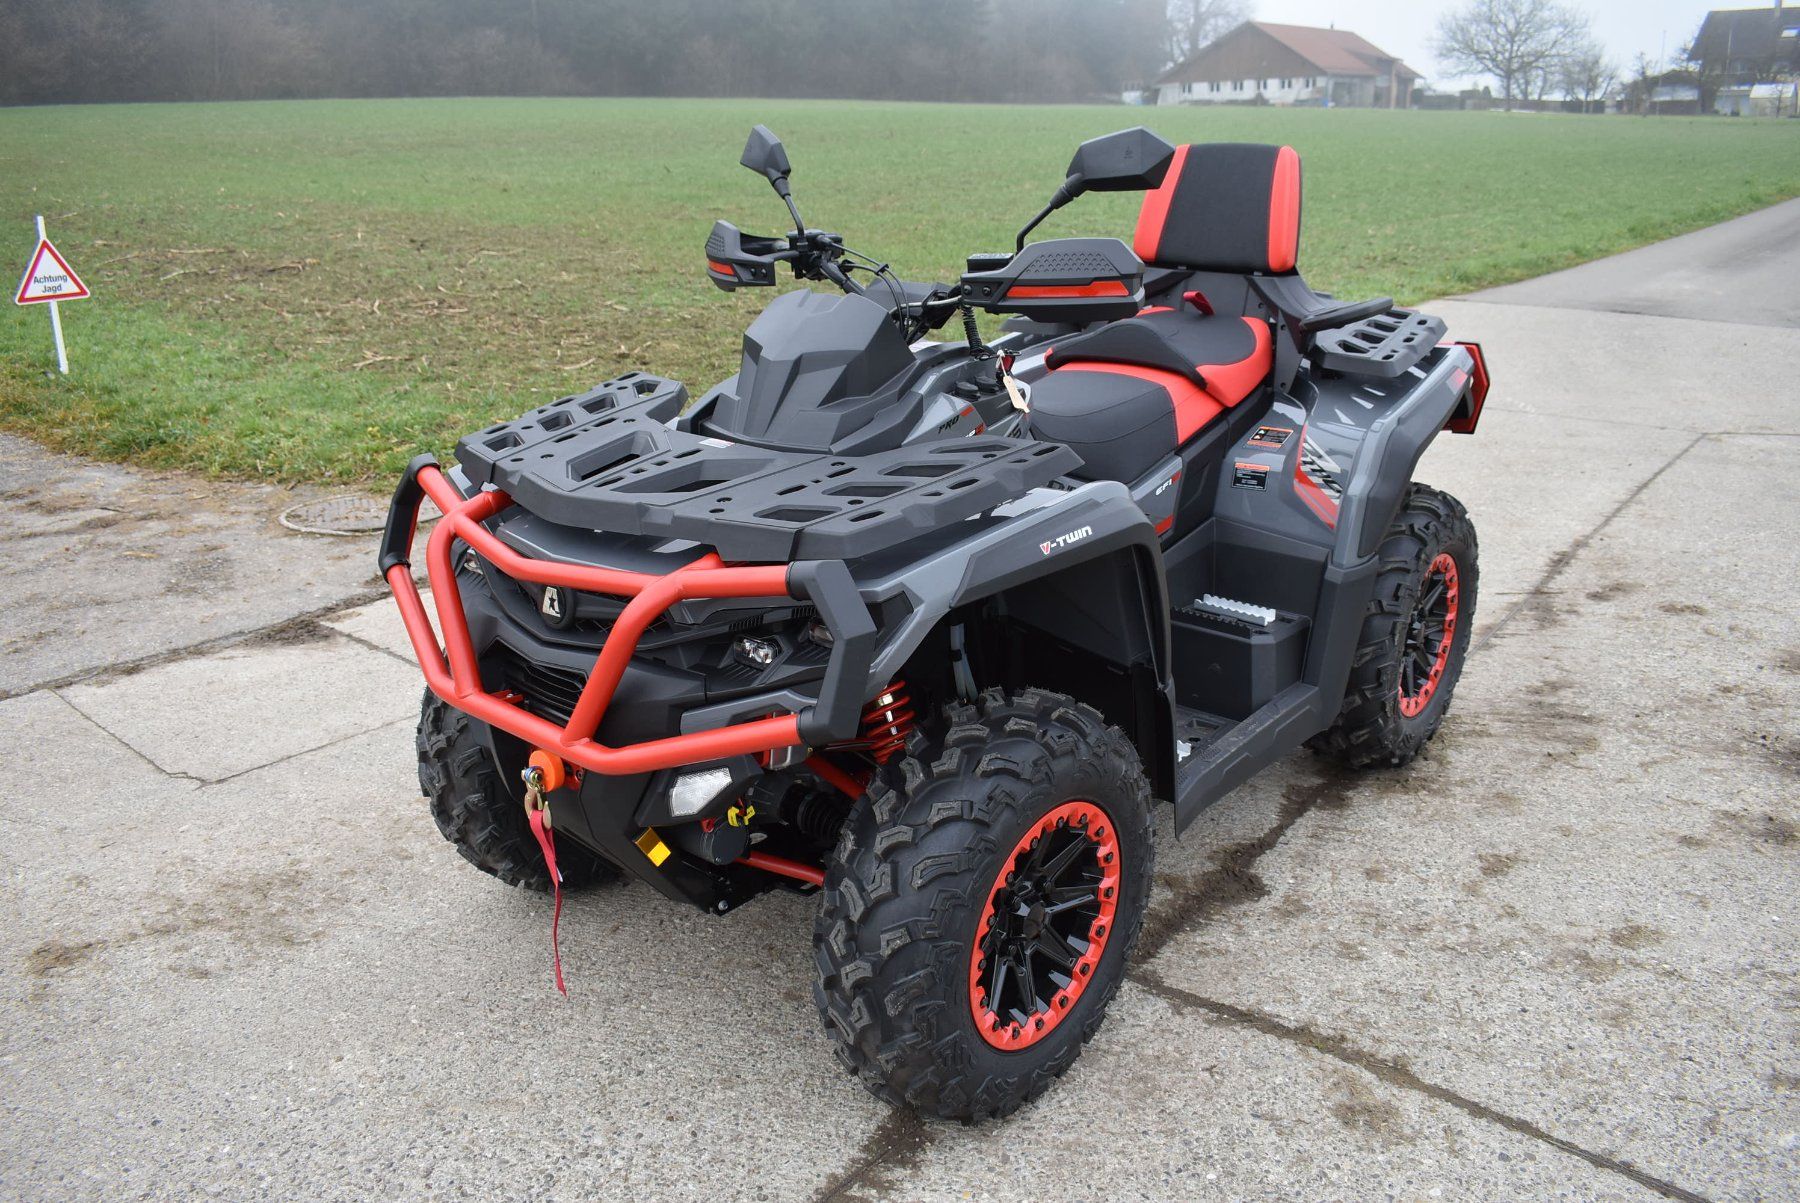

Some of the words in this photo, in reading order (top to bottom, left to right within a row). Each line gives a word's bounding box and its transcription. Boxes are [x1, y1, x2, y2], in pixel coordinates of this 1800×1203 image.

[33, 274, 68, 284] Achtung
[42, 284, 62, 293] Jagd
[1040, 525, 1092, 555] V-TWIN
